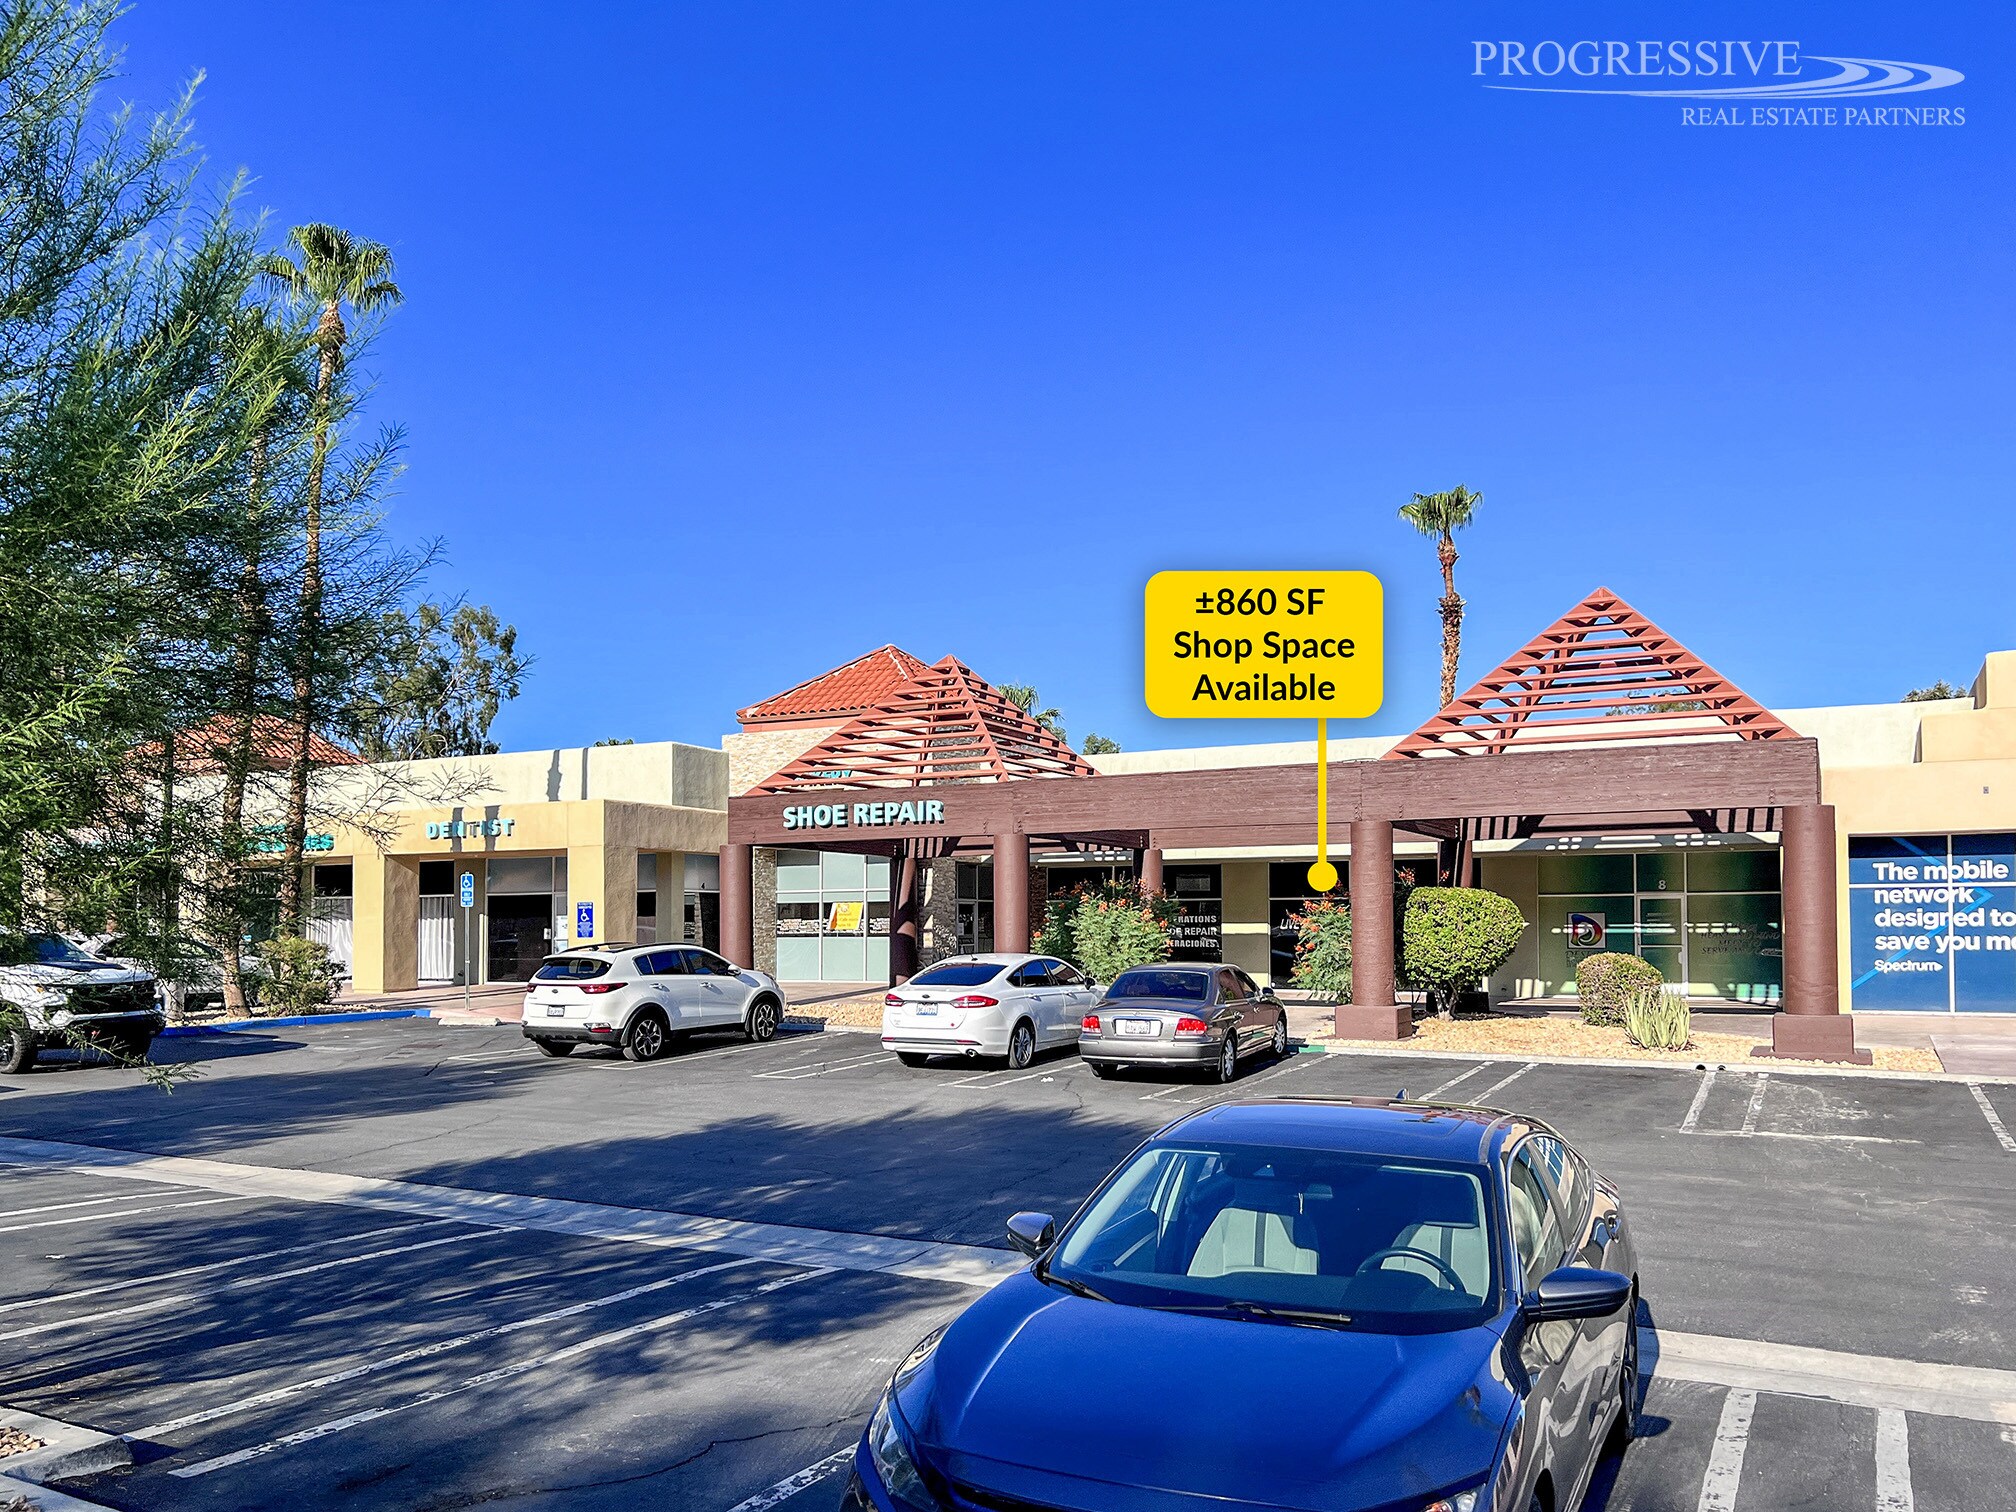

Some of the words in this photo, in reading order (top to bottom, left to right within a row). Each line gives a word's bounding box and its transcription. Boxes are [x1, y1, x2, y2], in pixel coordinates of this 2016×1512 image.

[782, 803, 848, 830] SHOE
[852, 799, 944, 827] REPAIR
[425, 818, 514, 840] DENTIST
[1872, 861, 1919, 881] The
[1923, 859, 2009, 881] mobile
[1657, 879, 1667, 890] 8
[1874, 886, 1975, 905] network
[1874, 907, 1985, 931] designed
[1989, 908, 2016, 928] to
[1184, 926, 1218, 936] REPAIR
[1874, 935, 1931, 951] save
[1934, 934, 1981, 954] you
[1874, 960, 1937, 974] Spectrum
